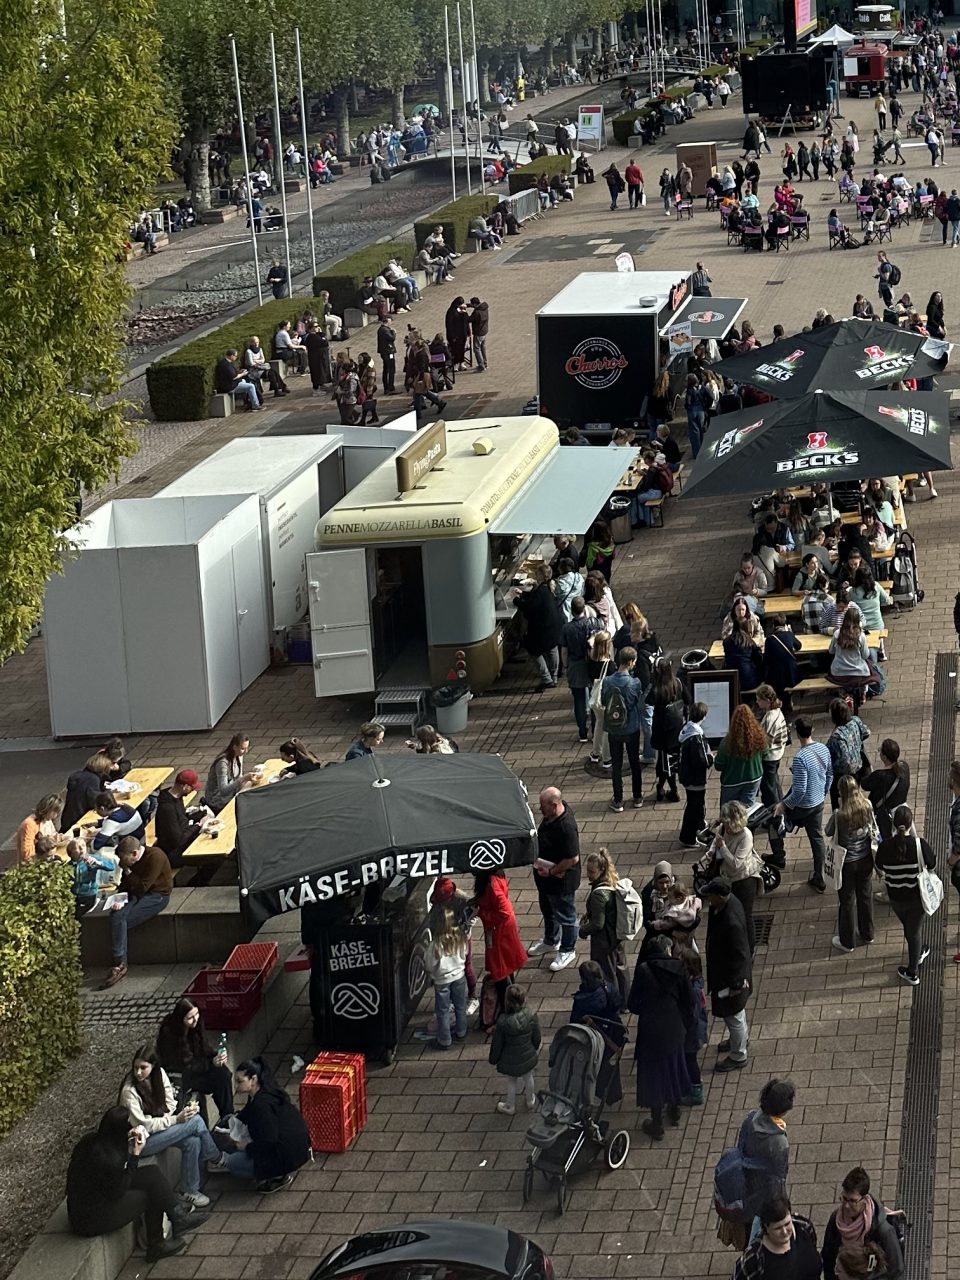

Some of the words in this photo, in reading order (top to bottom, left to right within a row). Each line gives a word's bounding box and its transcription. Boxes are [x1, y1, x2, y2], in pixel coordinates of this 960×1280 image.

[565, 354, 629, 375] Churros
[755, 363, 794, 382] BECK'S
[855, 354, 915, 379] BECK'S
[775, 451, 860, 473] BECK'S
[278, 849, 454, 913] KÄSE-BREZEL
[330, 940, 372, 958] KÄSE-
[329, 952, 379, 971] BREZEL
